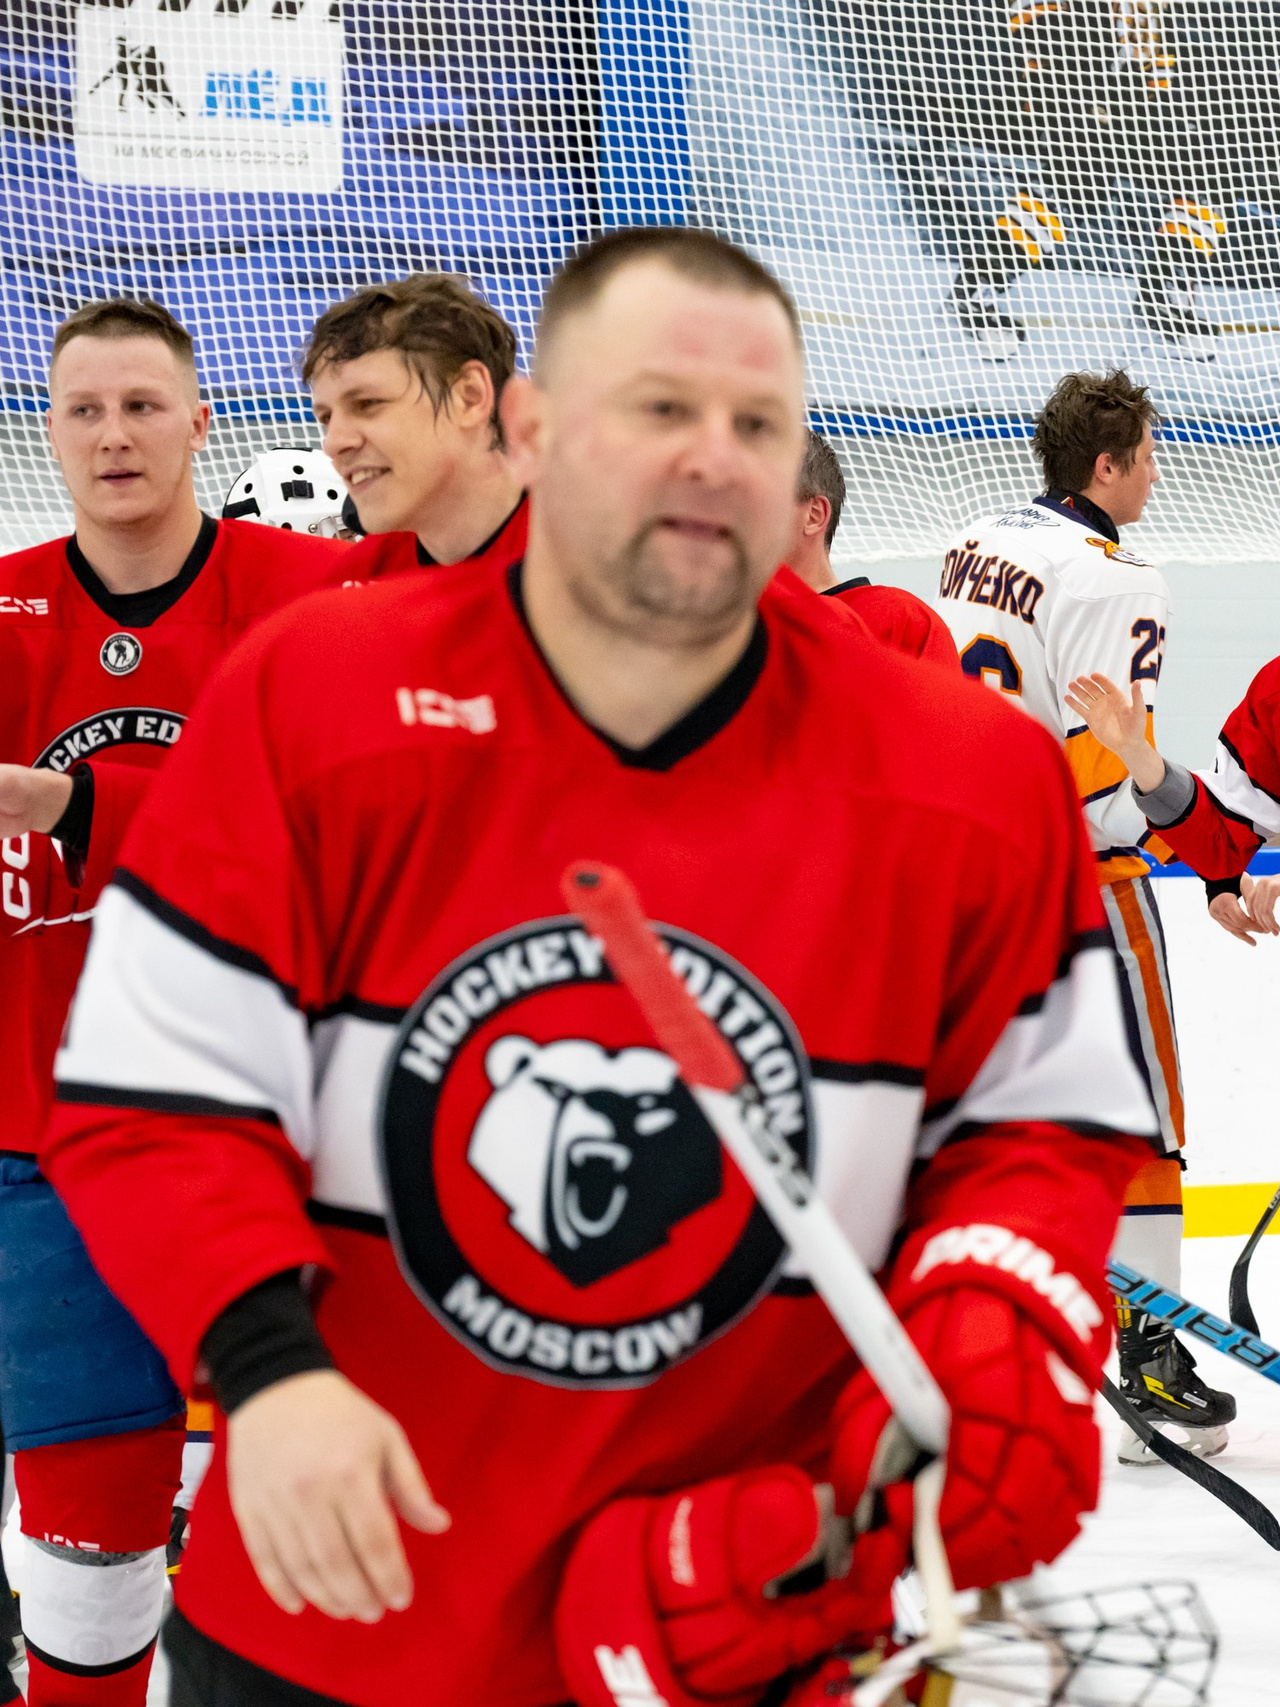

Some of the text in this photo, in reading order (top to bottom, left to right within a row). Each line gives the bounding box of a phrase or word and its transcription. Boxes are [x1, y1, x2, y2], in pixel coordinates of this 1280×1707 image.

[938, 539, 1045, 626] ОЙЧЕНКО
[49, 716, 126, 772] CKEY
[399, 929, 804, 1135] HOCKEY DITION
[442, 1273, 705, 1375] MOSCOW
